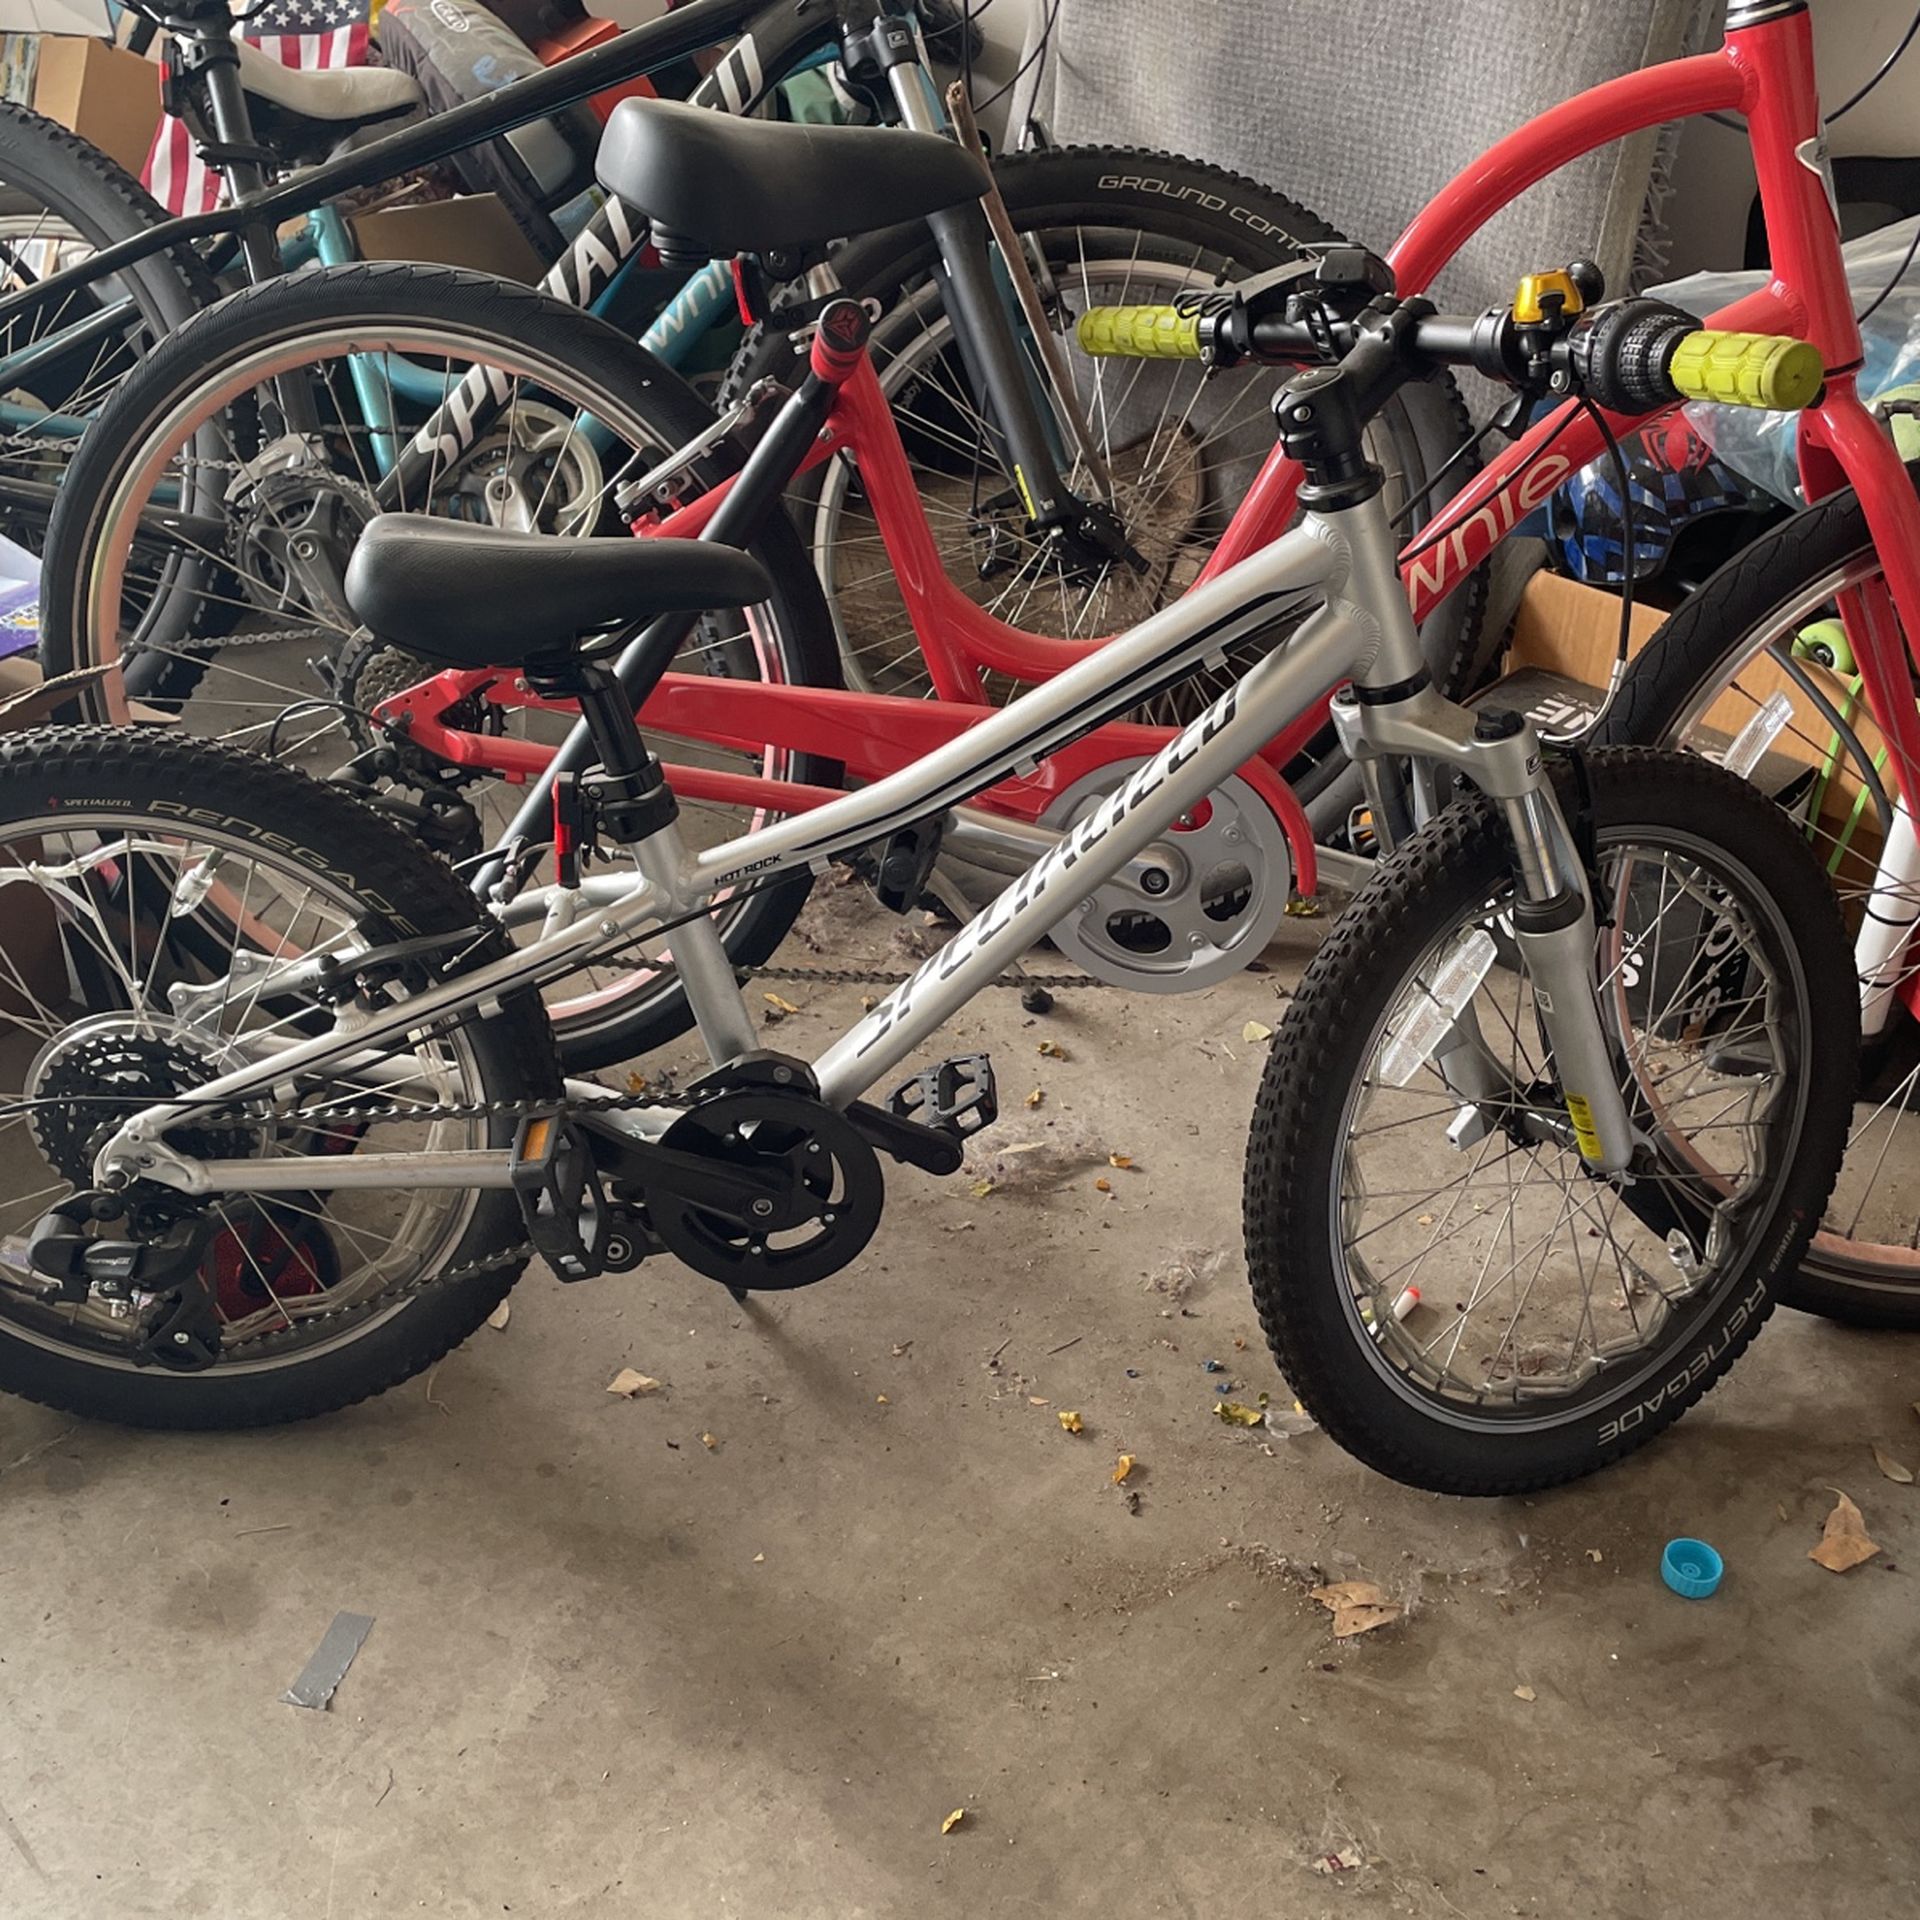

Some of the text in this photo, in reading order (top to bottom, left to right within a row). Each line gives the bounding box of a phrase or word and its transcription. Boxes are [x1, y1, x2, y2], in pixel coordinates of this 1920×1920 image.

[1098, 175, 1227, 212] GROUND
[1409, 454, 1570, 615] wnie
[146, 799, 422, 936] RENEGADE
[714, 853, 782, 885] HOT ROCK
[1597, 1277, 1767, 1446] RENEGADE
